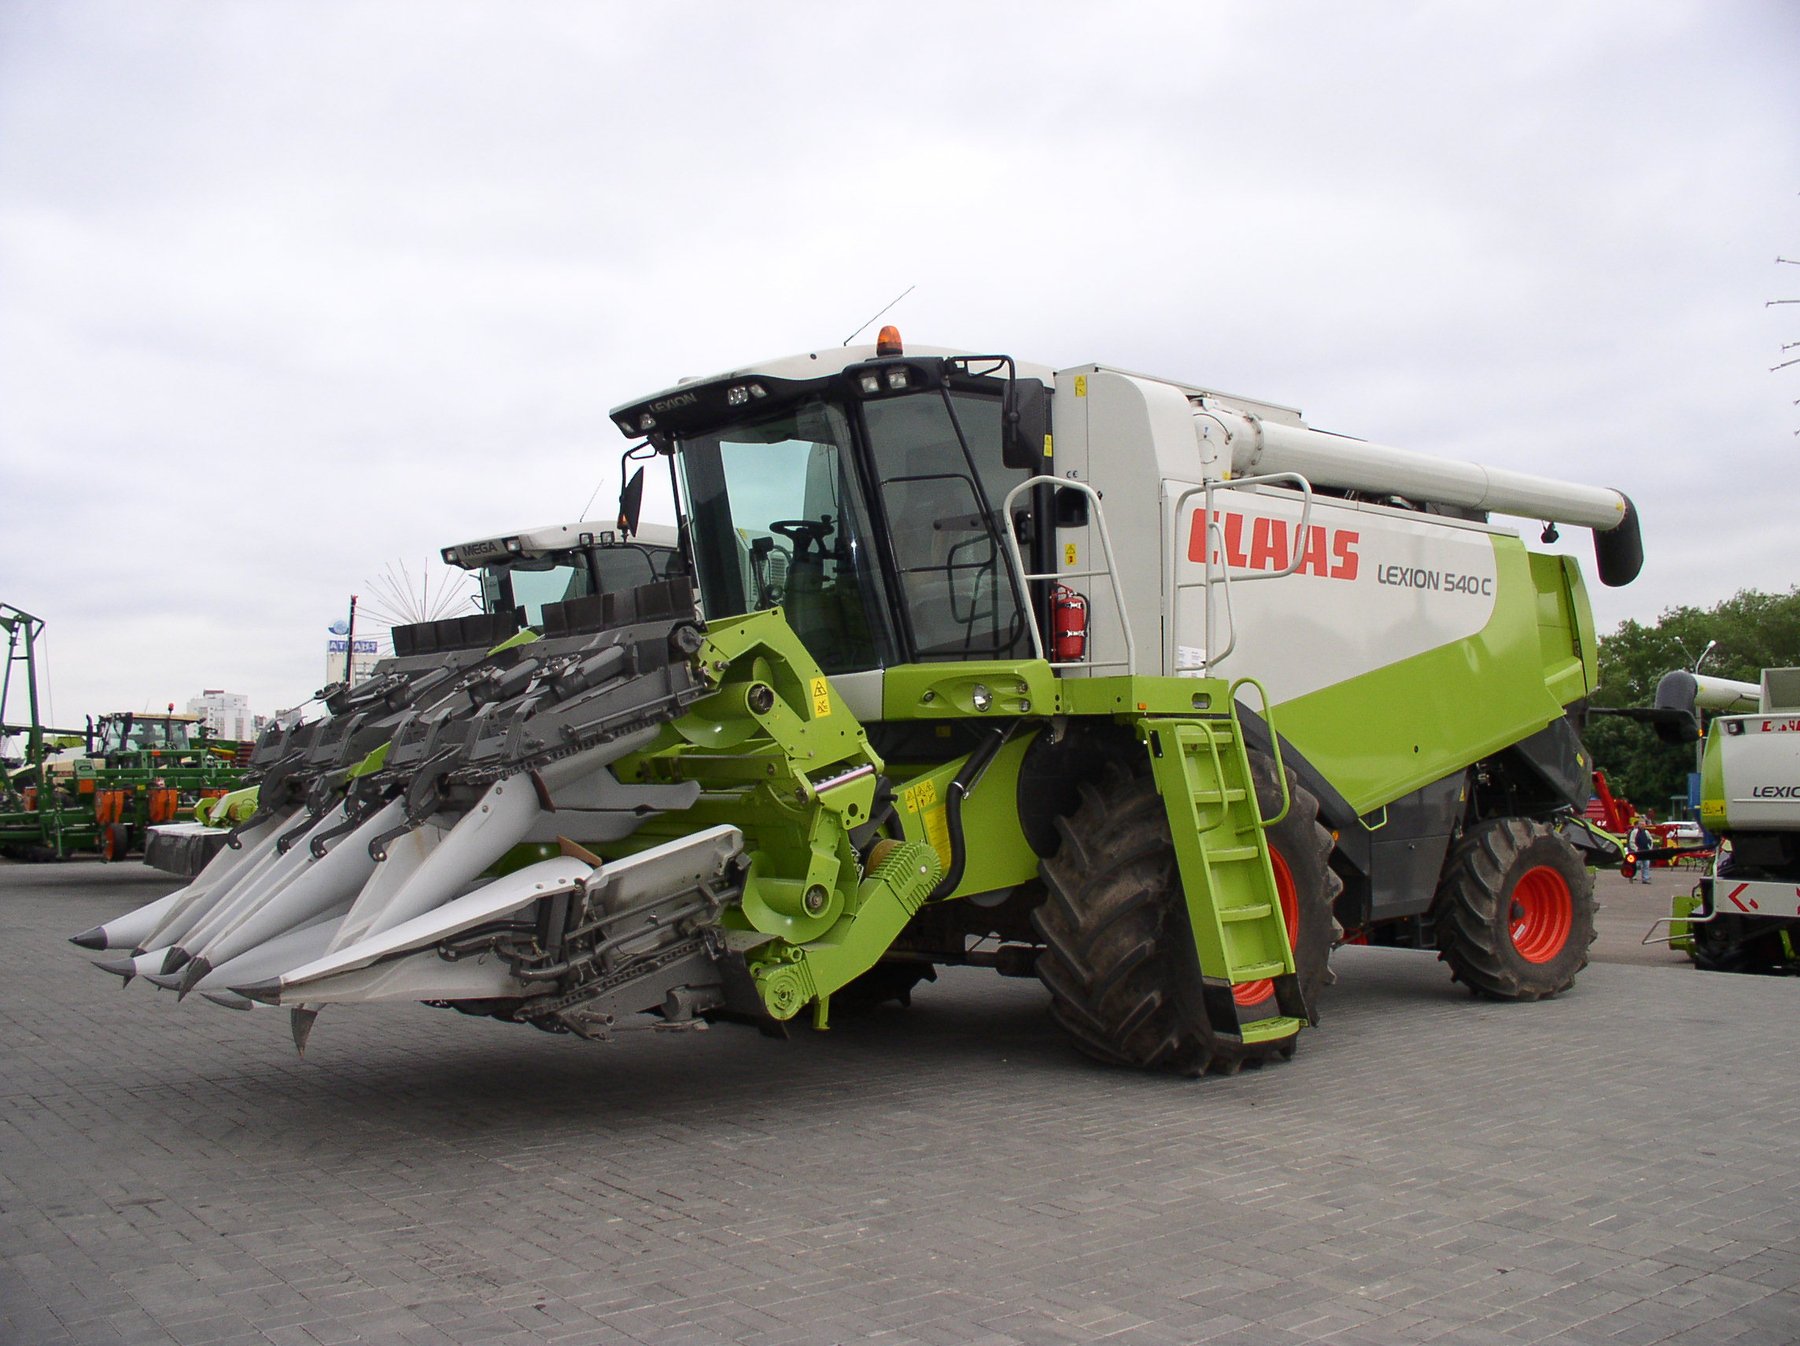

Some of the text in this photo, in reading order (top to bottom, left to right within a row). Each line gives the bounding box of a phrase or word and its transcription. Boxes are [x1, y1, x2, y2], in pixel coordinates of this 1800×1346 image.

[649, 392, 697, 412] LEXION
[462, 541, 497, 556] MEGA
[1188, 508, 1359, 580] CLAAS
[1377, 564, 1492, 596] LEXION 540 C
[329, 640, 377, 652] АТАНТ
